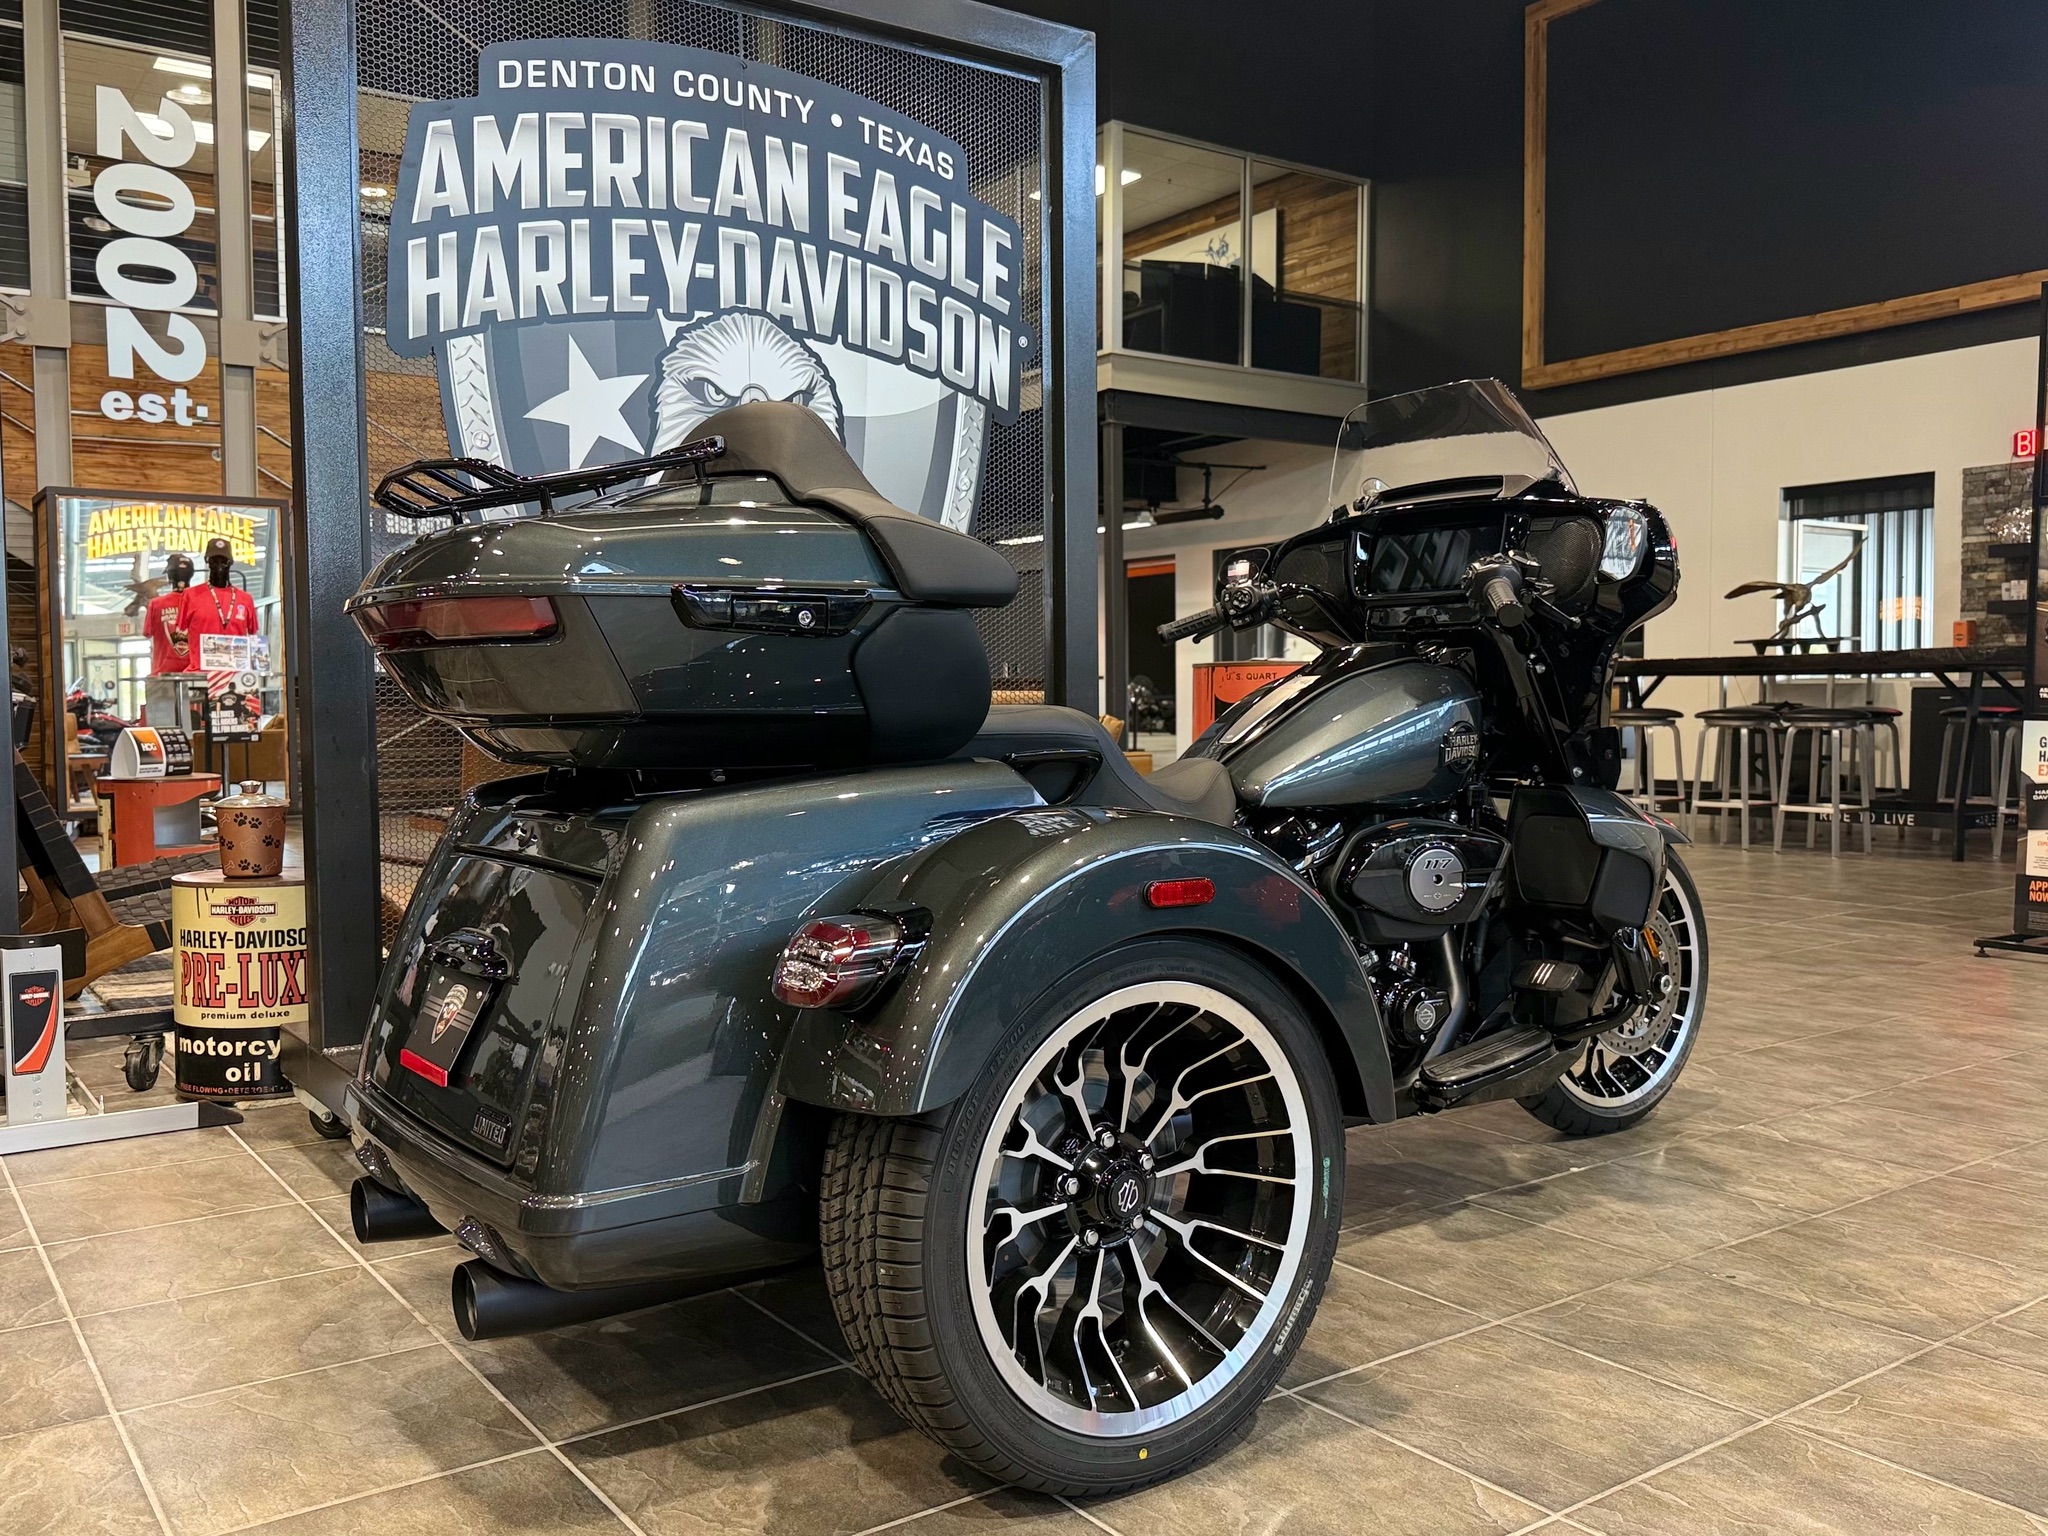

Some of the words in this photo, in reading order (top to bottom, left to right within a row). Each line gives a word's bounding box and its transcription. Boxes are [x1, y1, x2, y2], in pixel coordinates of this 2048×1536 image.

[498, 59, 655, 93] DENTON
[672, 70, 814, 125] COUNTY
[858, 115, 955, 180] TEXAS
[411, 112, 810, 234] AMERICAN
[826, 152, 1013, 316] EAGLE
[93, 84, 207, 382] 2002
[407, 218, 1012, 411] HARLEY-DAVIDSON
[100, 388, 208, 426] est.
[88, 504, 192, 536] AMERICAN
[195, 506, 255, 542] EAGLE
[86, 527, 256, 566] HARLEY-DAVION
[1246, 672, 1278, 681] QUART
[2039, 751, 2048, 763] H
[1820, 812, 1851, 823] RIE
[1884, 813, 1915, 826] LIVE
[1423, 858, 1454, 870] 117
[228, 896, 255, 905] MOTOR
[211, 905, 274, 914] HARLEY-DAVIDSON
[229, 915, 254, 926] CYCLES
[201, 1011, 246, 1020] premium
[250, 1010, 290, 1019] deluxe
[225, 1062, 261, 1082] oil
[192, 1085, 223, 1094] FLOWING
[472, 1114, 506, 1144] LIMITED
